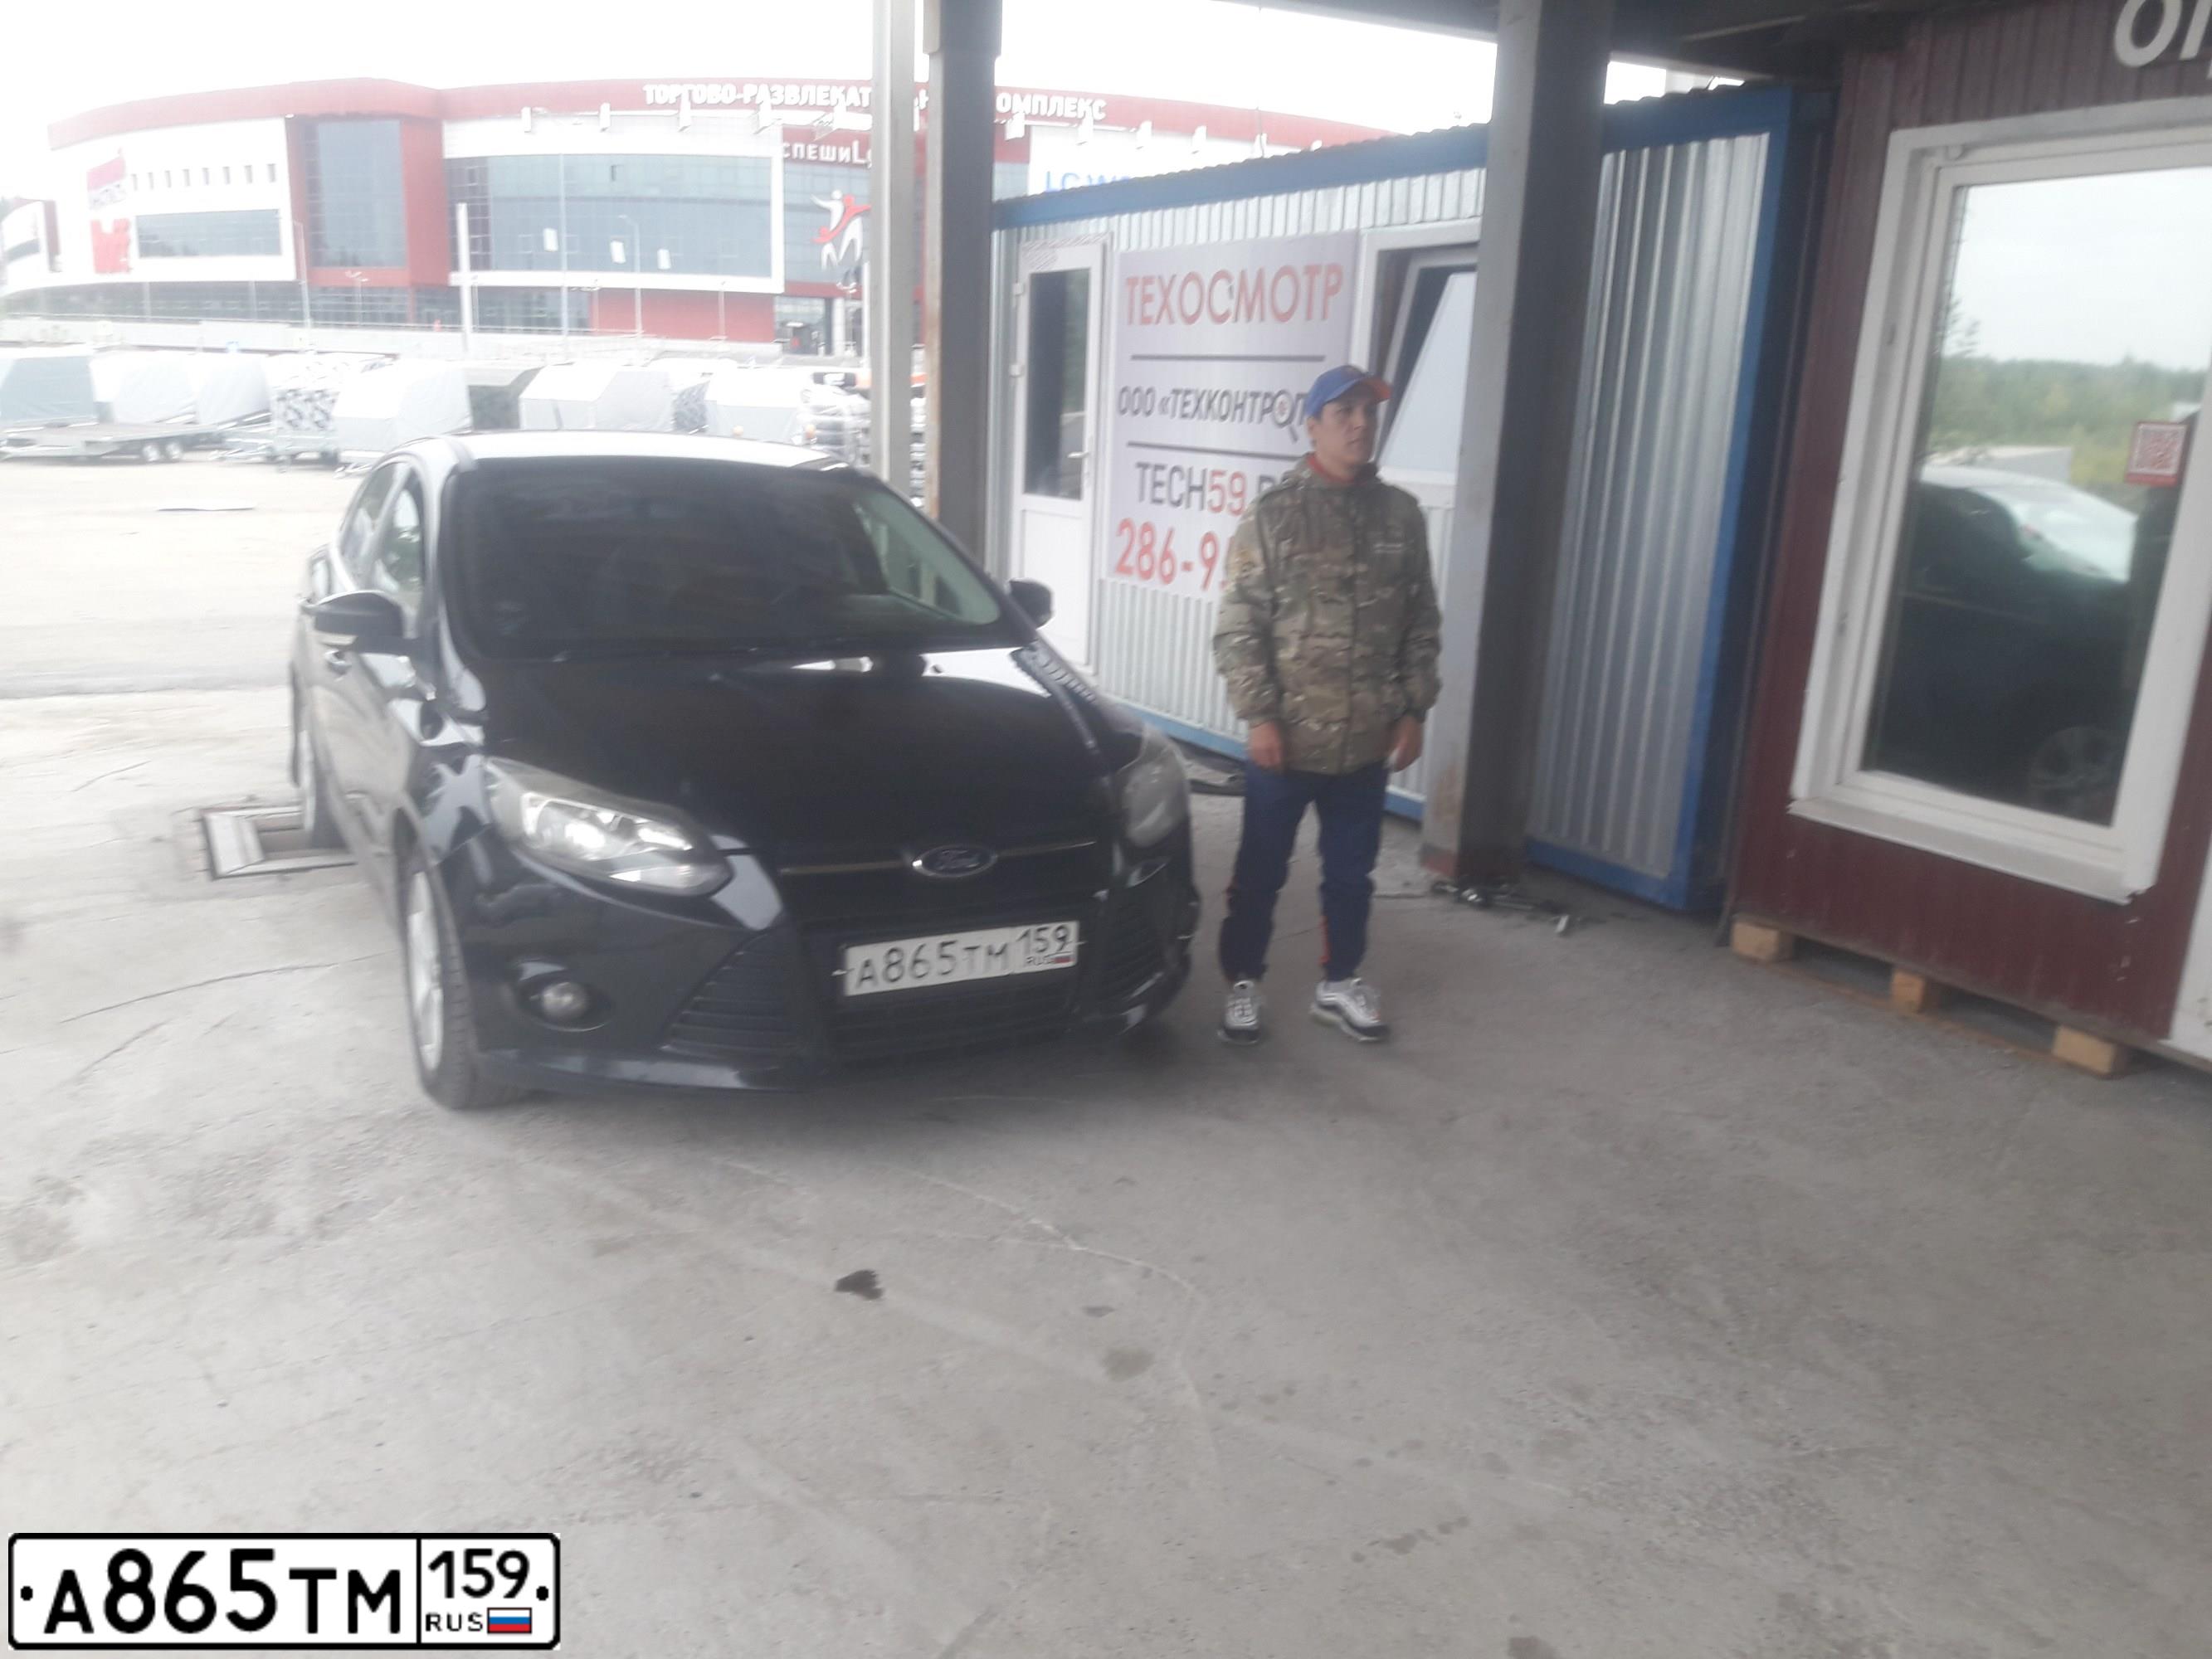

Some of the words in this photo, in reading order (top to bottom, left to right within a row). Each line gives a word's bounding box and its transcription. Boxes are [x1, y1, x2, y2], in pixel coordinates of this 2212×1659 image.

[643, 83, 930, 108] ТОРГОВО-РАЗВЛЕКАТ
[996, 92, 1106, 120] ОМПЛЕКС
[1125, 265, 1343, 325] ТЕХОСМОТР
[1118, 386, 1156, 416] ООО
[1115, 518, 1230, 591] 286-9
[855, 940, 1011, 989] А865ТМ
[1015, 924, 1069, 954] 159
